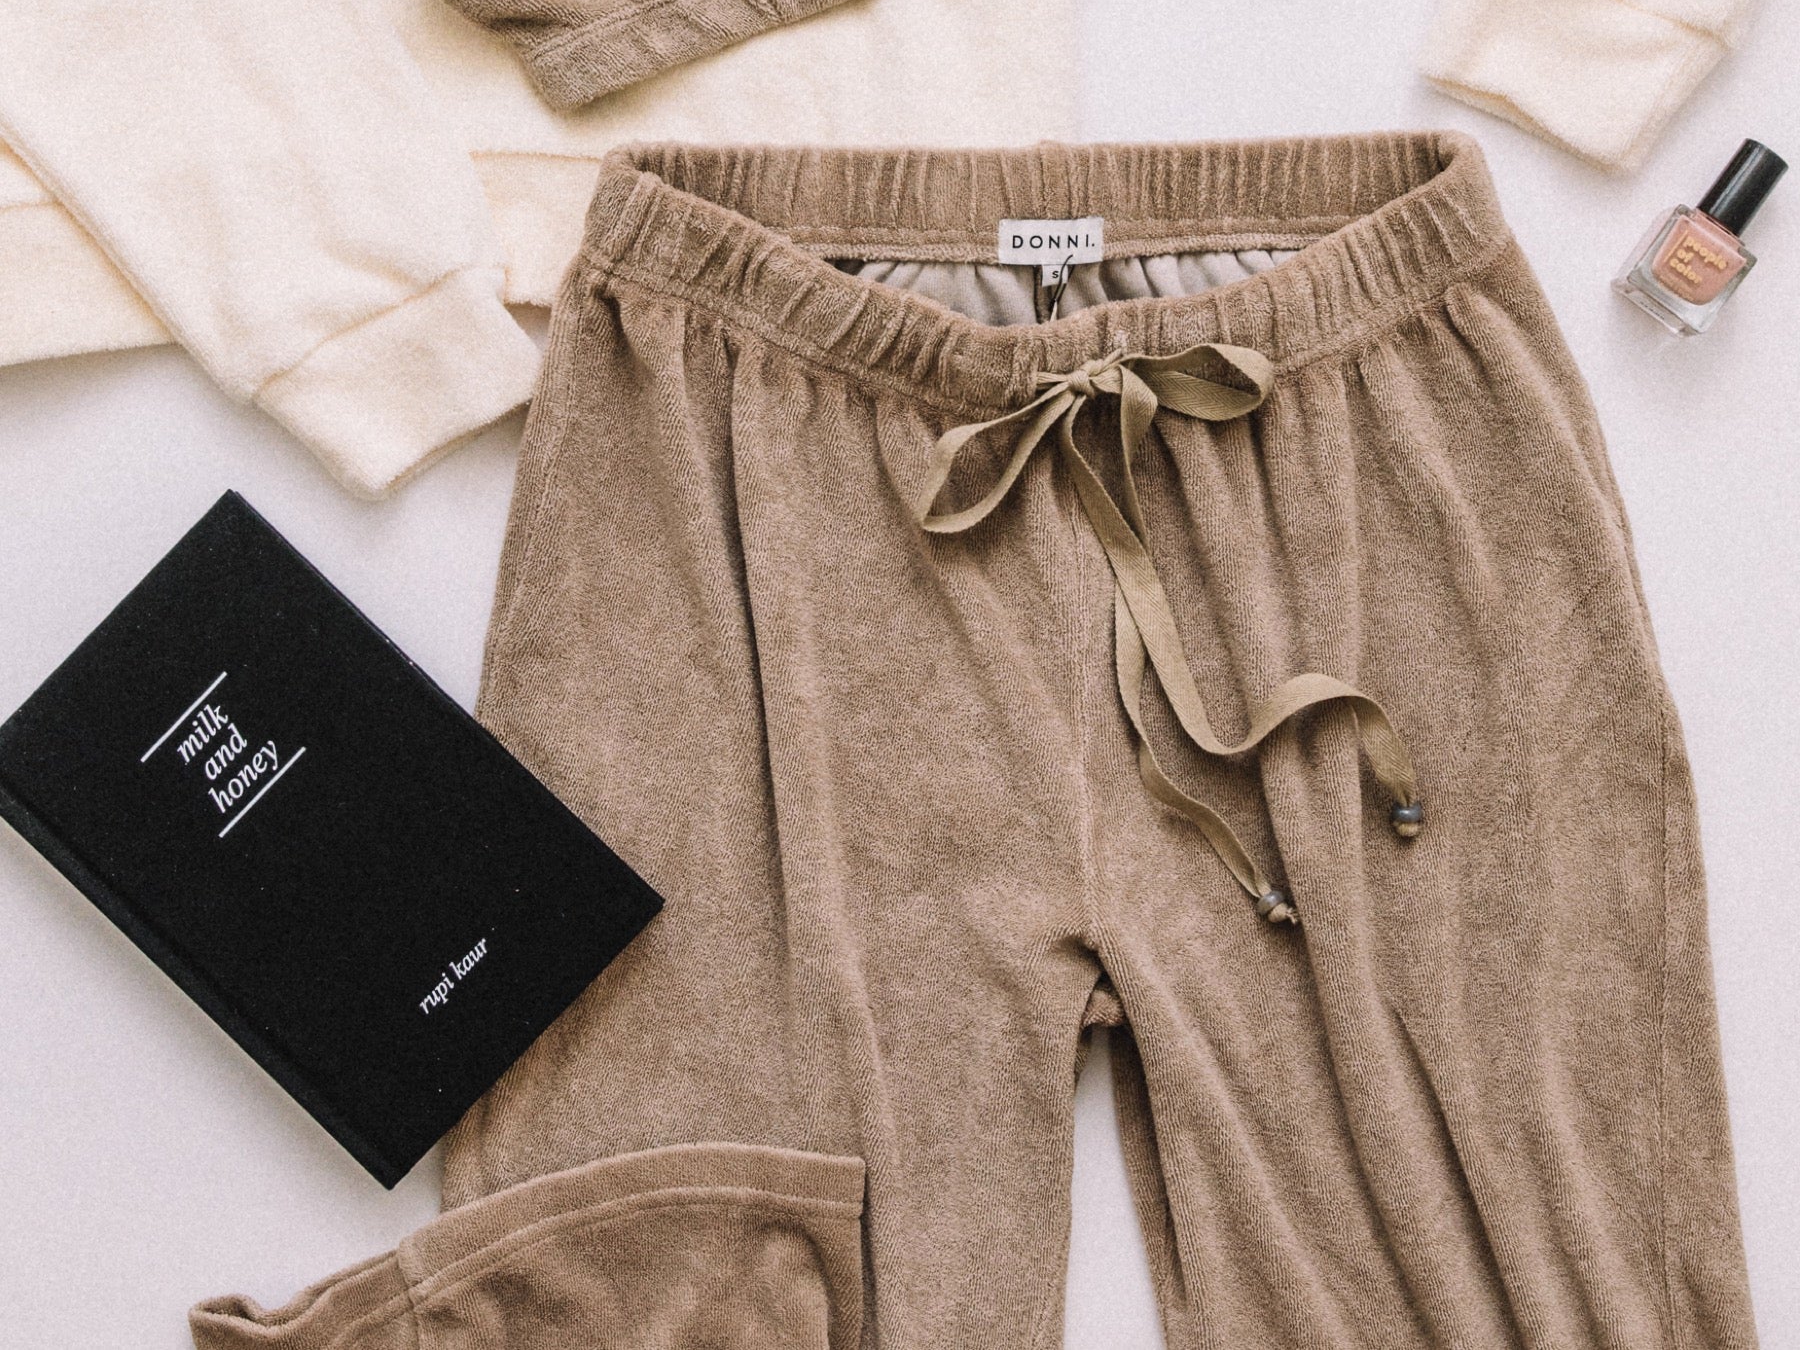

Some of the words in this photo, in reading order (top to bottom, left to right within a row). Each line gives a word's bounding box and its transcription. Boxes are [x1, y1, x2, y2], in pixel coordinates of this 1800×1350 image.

[1011, 234, 1096, 249] DONNI.
[1676, 248, 1694, 263] of
[1682, 235, 1727, 270] people
[1669, 258, 1703, 284] color
[176, 704, 229, 763] milk
[204, 722, 248, 780] and
[208, 740, 279, 813] honey
[419, 972, 455, 1015] rupi
[448, 937, 488, 981] kaur
